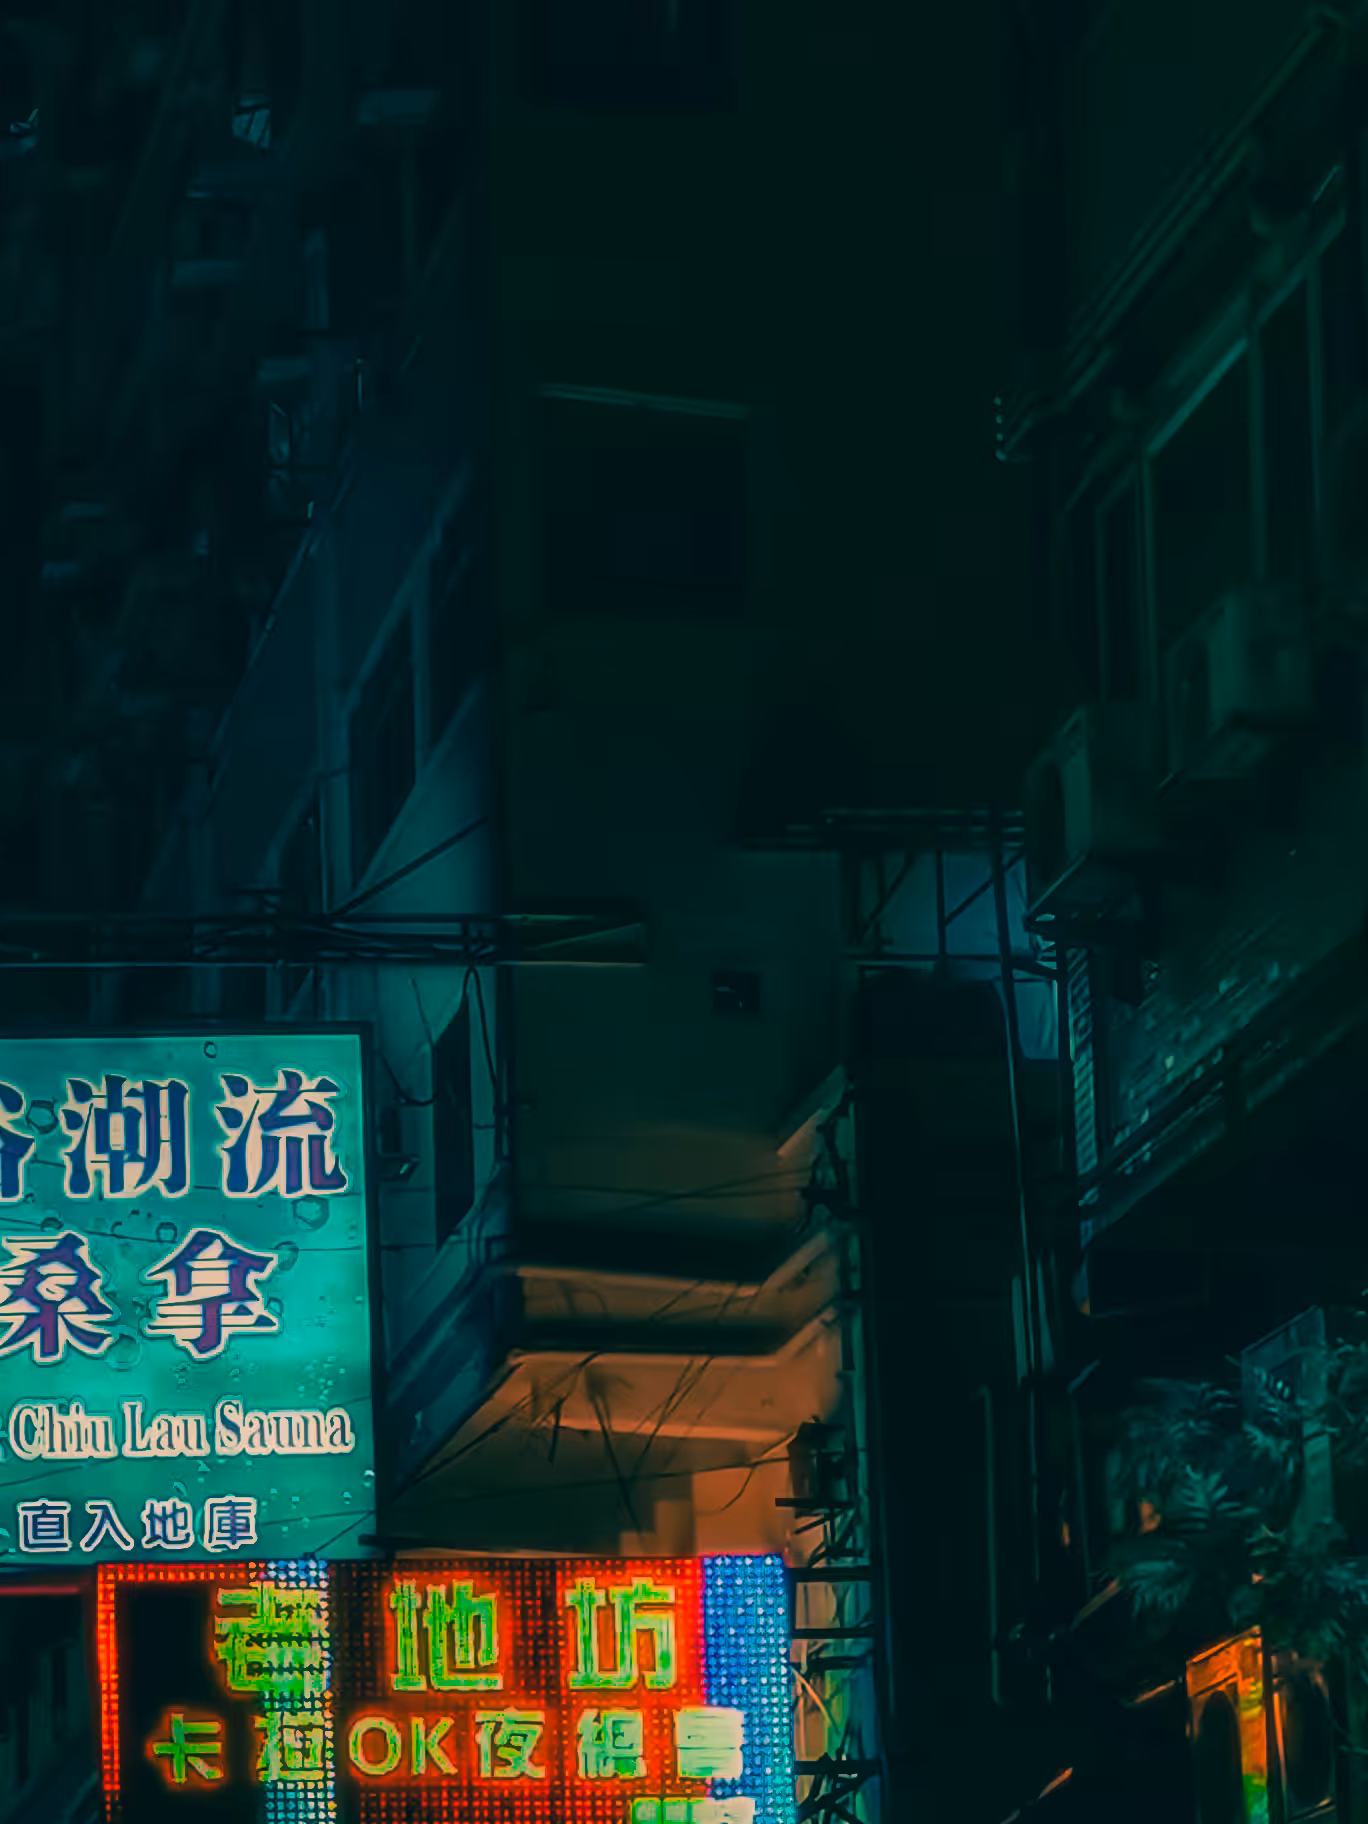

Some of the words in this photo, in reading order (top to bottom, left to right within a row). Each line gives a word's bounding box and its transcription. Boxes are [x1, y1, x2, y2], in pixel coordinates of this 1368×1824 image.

[10, 1402, 119, 1460] Chiu
[122, 1402, 209, 1458] Lau
[215, 1400, 353, 1456] Sauna
[18, 1497, 259, 1552] 直入地庫
